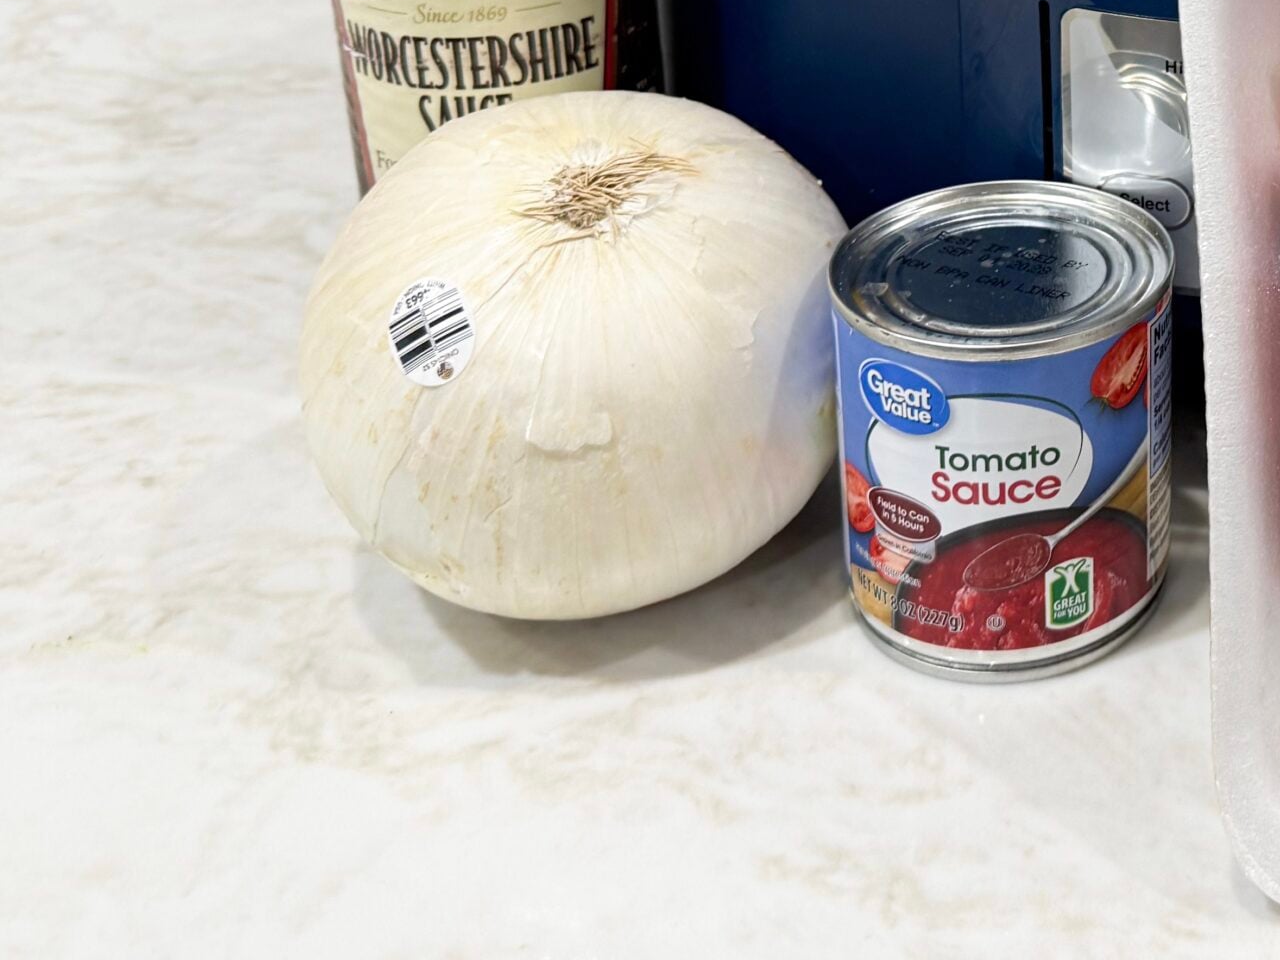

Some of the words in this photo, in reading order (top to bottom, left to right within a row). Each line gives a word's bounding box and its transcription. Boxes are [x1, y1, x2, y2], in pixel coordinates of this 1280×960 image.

[412, 2, 465, 25] Since
[468, 5, 508, 23] 1869
[347, 15, 600, 91] WORCESTERSHIRE
[1063, 259, 1089, 270] BY
[975, 271, 1010, 288] CAN
[1015, 281, 1072, 300] LINER
[867, 368, 932, 411] Great
[881, 396, 932, 425] Value
[935, 445, 1062, 473] Tomato
[931, 471, 1062, 506] Sauce
[877, 495, 896, 513] Field
[898, 506, 907, 517] to
[909, 510, 930, 524] Can
[882, 508, 890, 519] in
[898, 515, 925, 533] Hours
[858, 568, 871, 592] NET
[872, 583, 888, 604] WT
[890, 594, 899, 612] 8
[899, 599, 916, 620] OZ
[1054, 591, 1086, 611] GREAT
[1067, 602, 1086, 618] YOU
